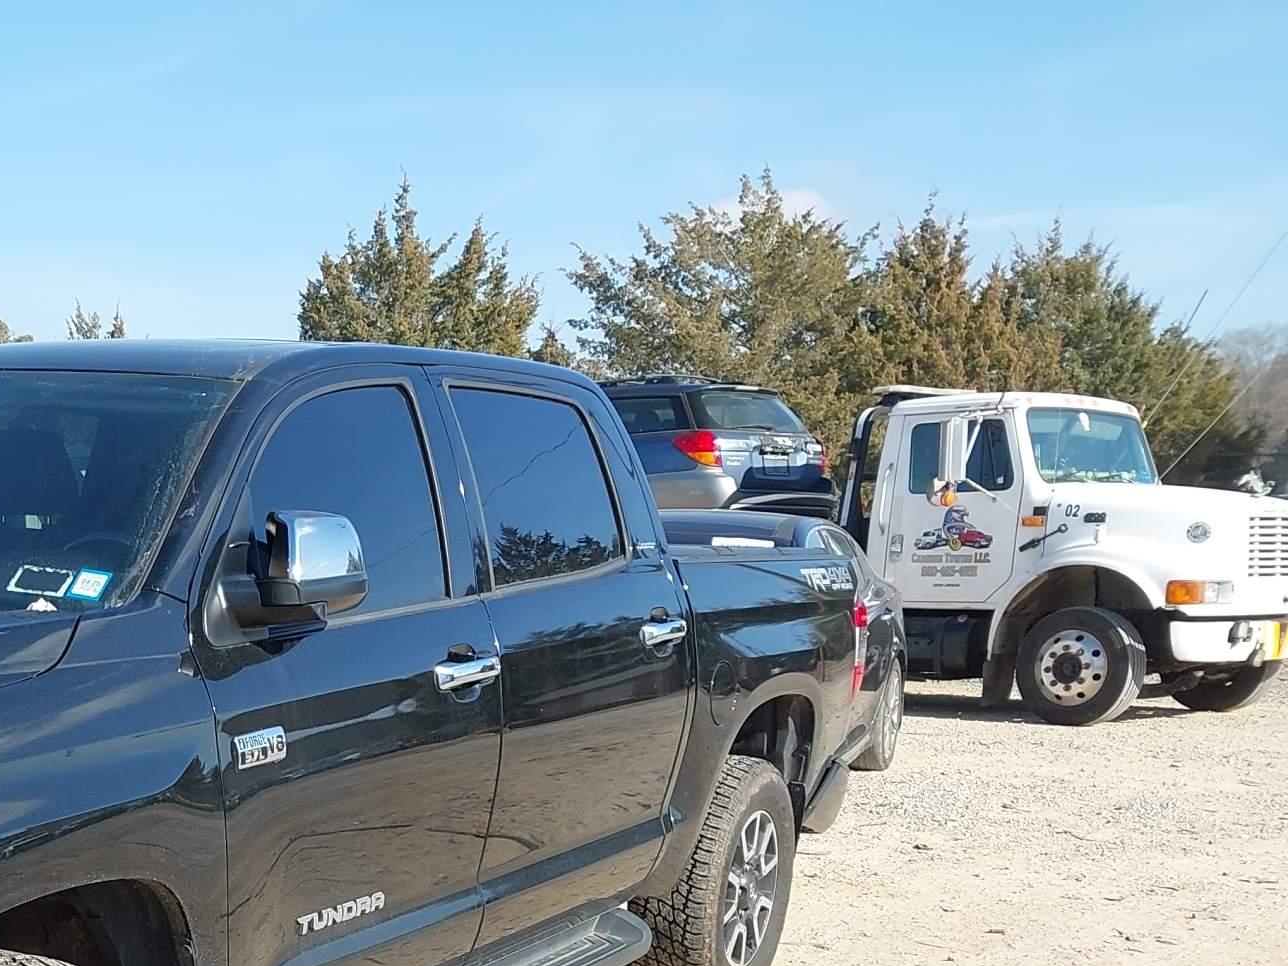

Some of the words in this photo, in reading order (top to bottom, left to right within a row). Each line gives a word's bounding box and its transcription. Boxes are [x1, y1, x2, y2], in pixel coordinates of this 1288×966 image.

[1065, 504, 1080, 517] 02
[800, 568, 831, 592] TRD
[267, 735, 285, 754] V8
[296, 891, 386, 936] TUNDRA
